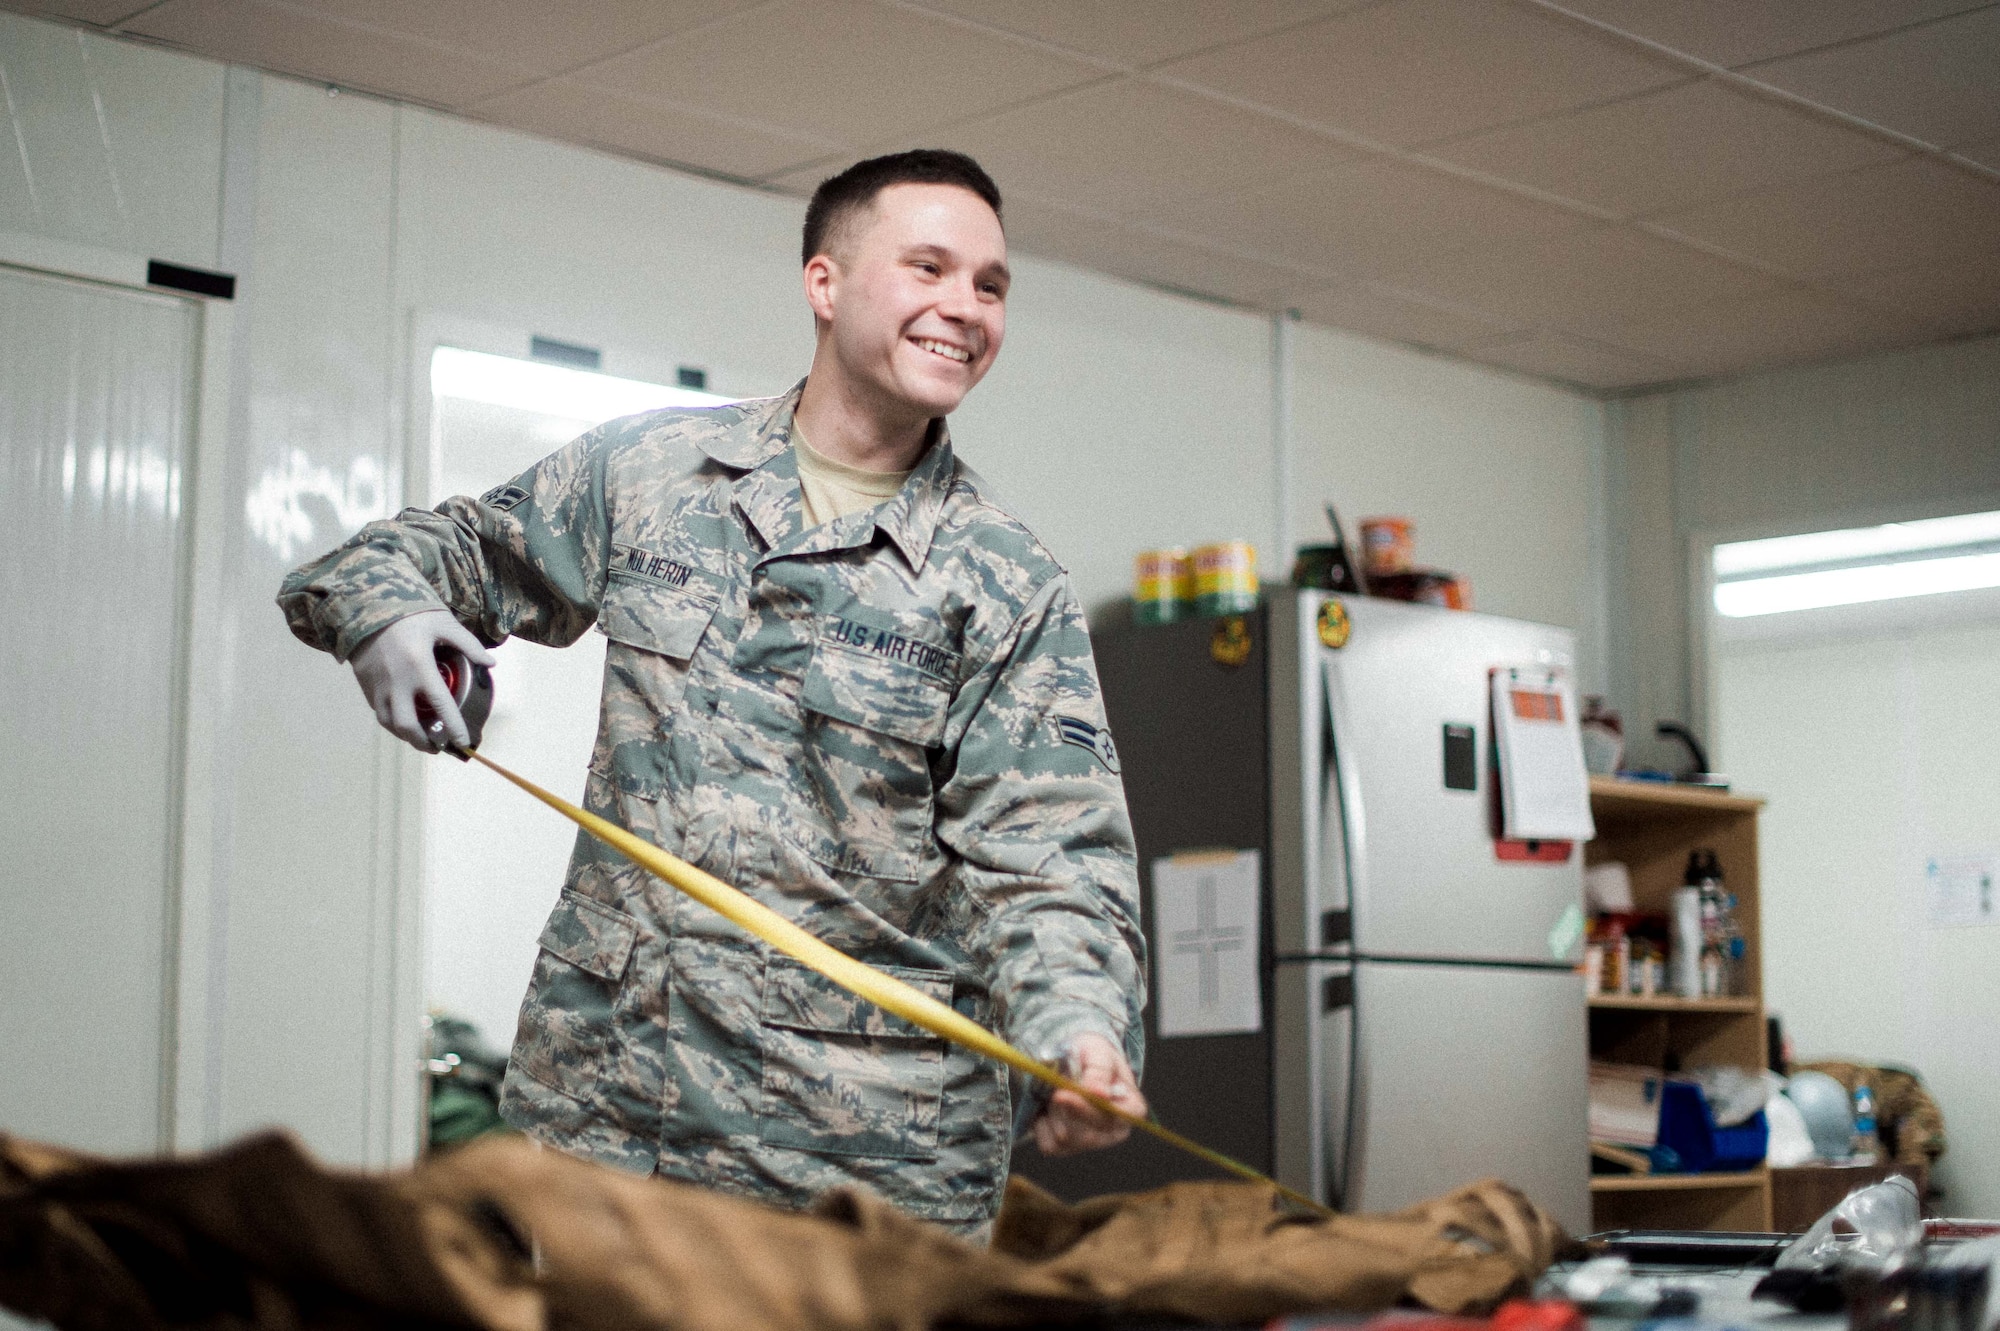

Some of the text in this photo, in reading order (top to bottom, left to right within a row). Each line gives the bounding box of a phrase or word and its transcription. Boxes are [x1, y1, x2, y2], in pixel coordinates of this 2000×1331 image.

[626, 548, 693, 587] MULHERIN
[836, 619, 953, 677] U.S. AIR FORCE
